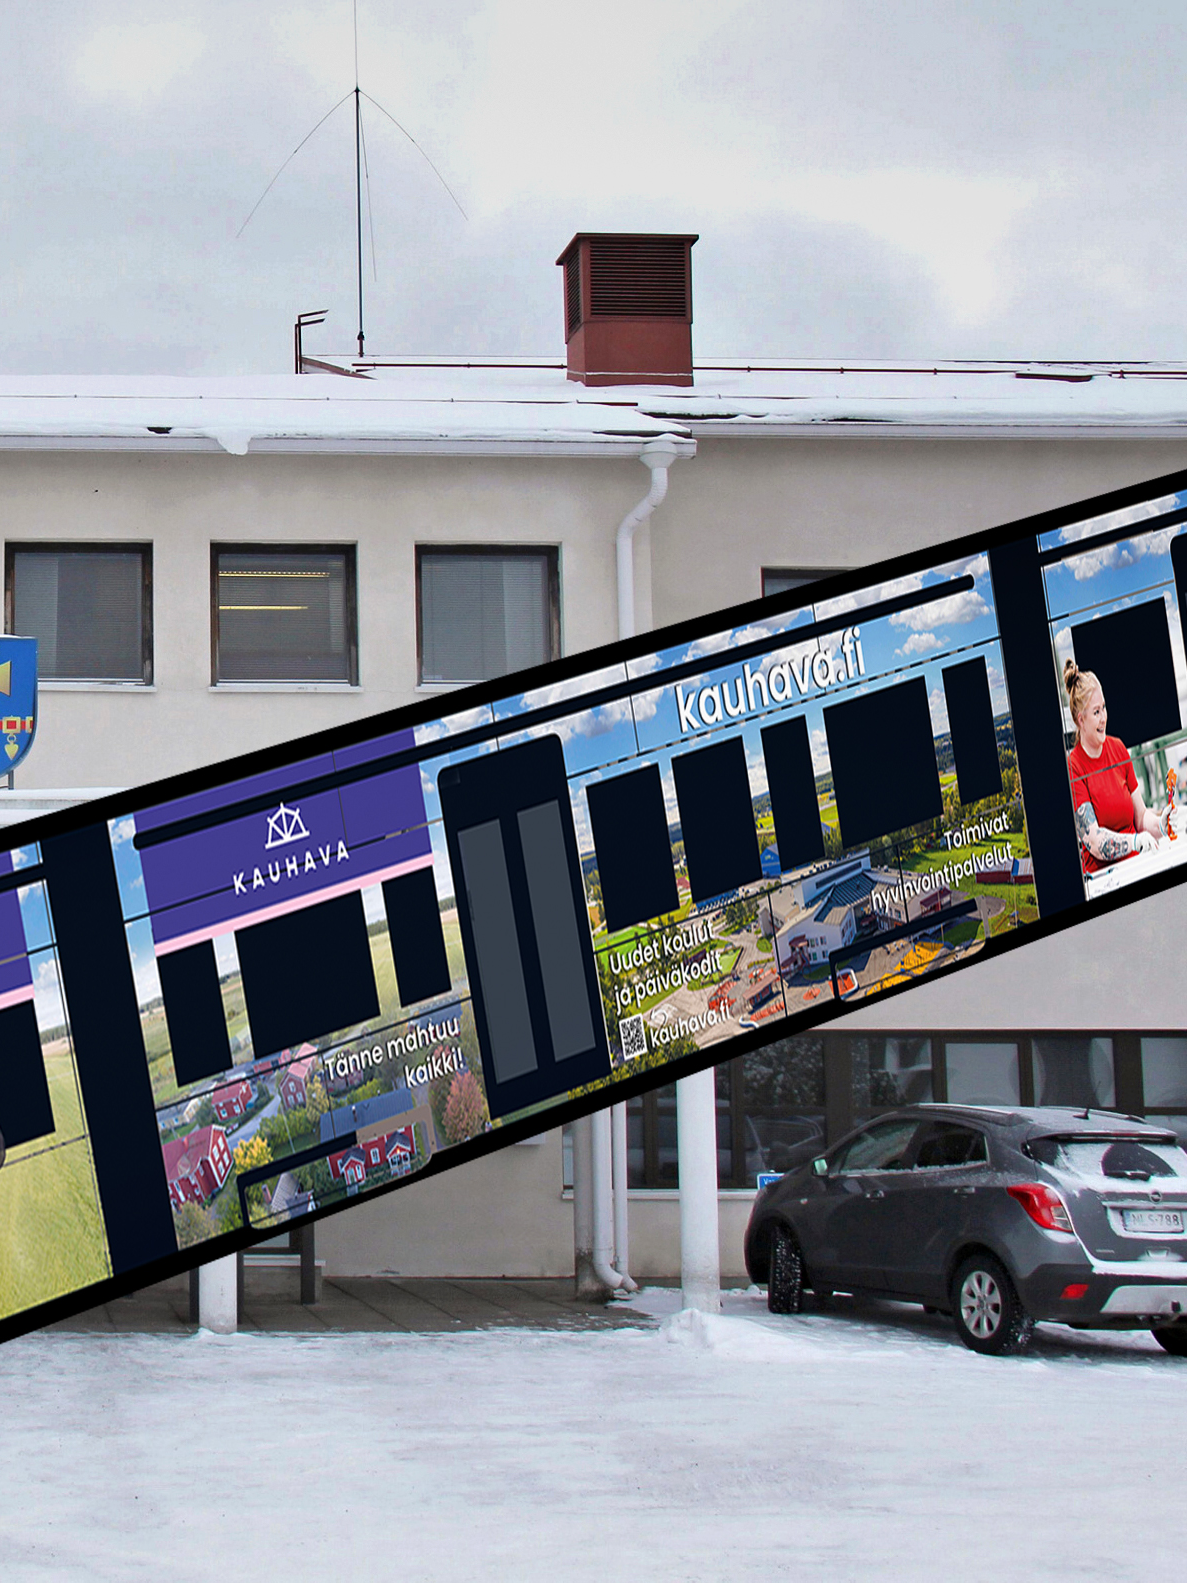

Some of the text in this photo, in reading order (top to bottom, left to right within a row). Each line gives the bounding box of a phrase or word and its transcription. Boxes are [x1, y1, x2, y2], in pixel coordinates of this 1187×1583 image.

[676, 627, 866, 733] kauhava.fi
[943, 811, 1010, 850] Toimivat
[233, 840, 350, 895] KAUHAVA
[871, 841, 1014, 913] hyvinvointipalvelut
[609, 919, 715, 974] Uudet koulut
[614, 951, 723, 1016] ja päiväkodit
[325, 1017, 459, 1080] Tänne mahtuu
[650, 999, 731, 1048] kauhava.fi
[404, 1047, 464, 1089] kaikki!
